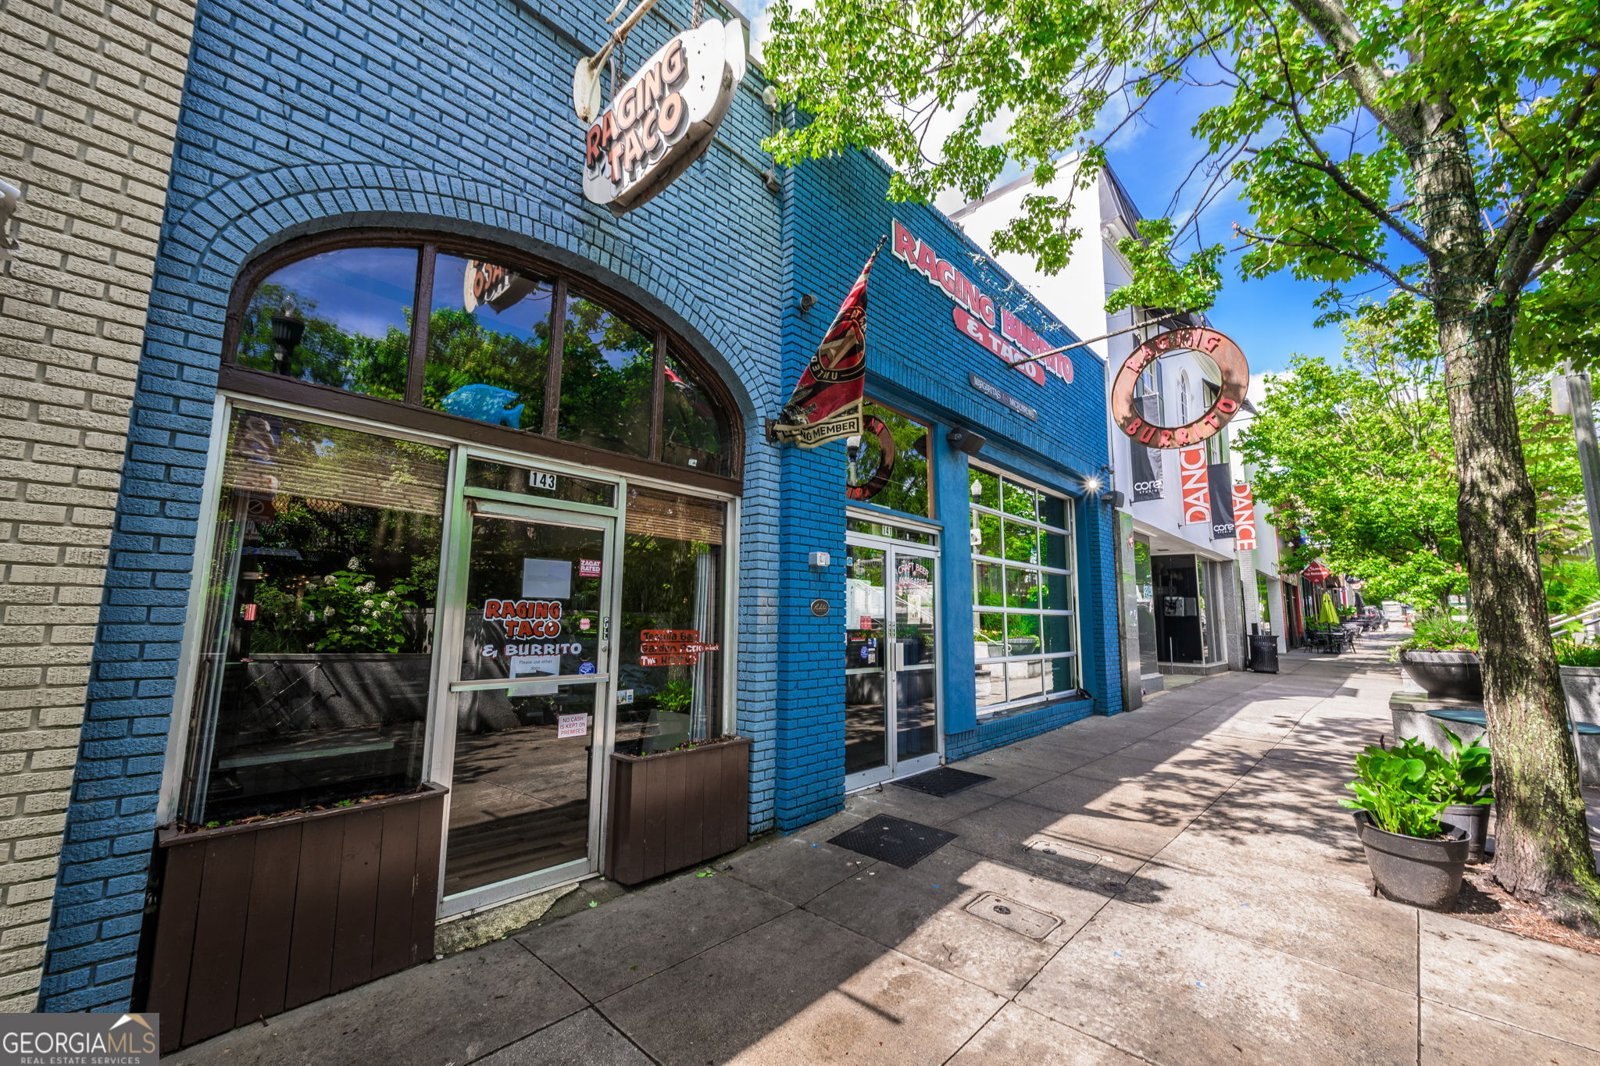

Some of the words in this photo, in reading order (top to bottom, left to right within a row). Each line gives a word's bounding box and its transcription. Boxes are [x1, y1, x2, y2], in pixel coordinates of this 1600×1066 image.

[586, 38, 685, 169] RAGING
[607, 91, 685, 184] TACO
[892, 217, 996, 329] RAGING
[966, 317, 984, 342] &
[988, 332, 1037, 378] TACO
[1125, 328, 1222, 374] RAGING
[813, 420, 856, 440] MEMBER
[1125, 397, 1238, 448] BURRITO
[532, 471, 556, 489] 143
[1134, 480, 1161, 491] core
[1180, 446, 1212, 525] DANC
[1213, 523, 1235, 532] core
[1232, 484, 1257, 550] DANCE
[484, 599, 561, 621] RAGING
[504, 620, 561, 640] TACO
[482, 645, 498, 657] &
[504, 643, 582, 656] BURRITO
